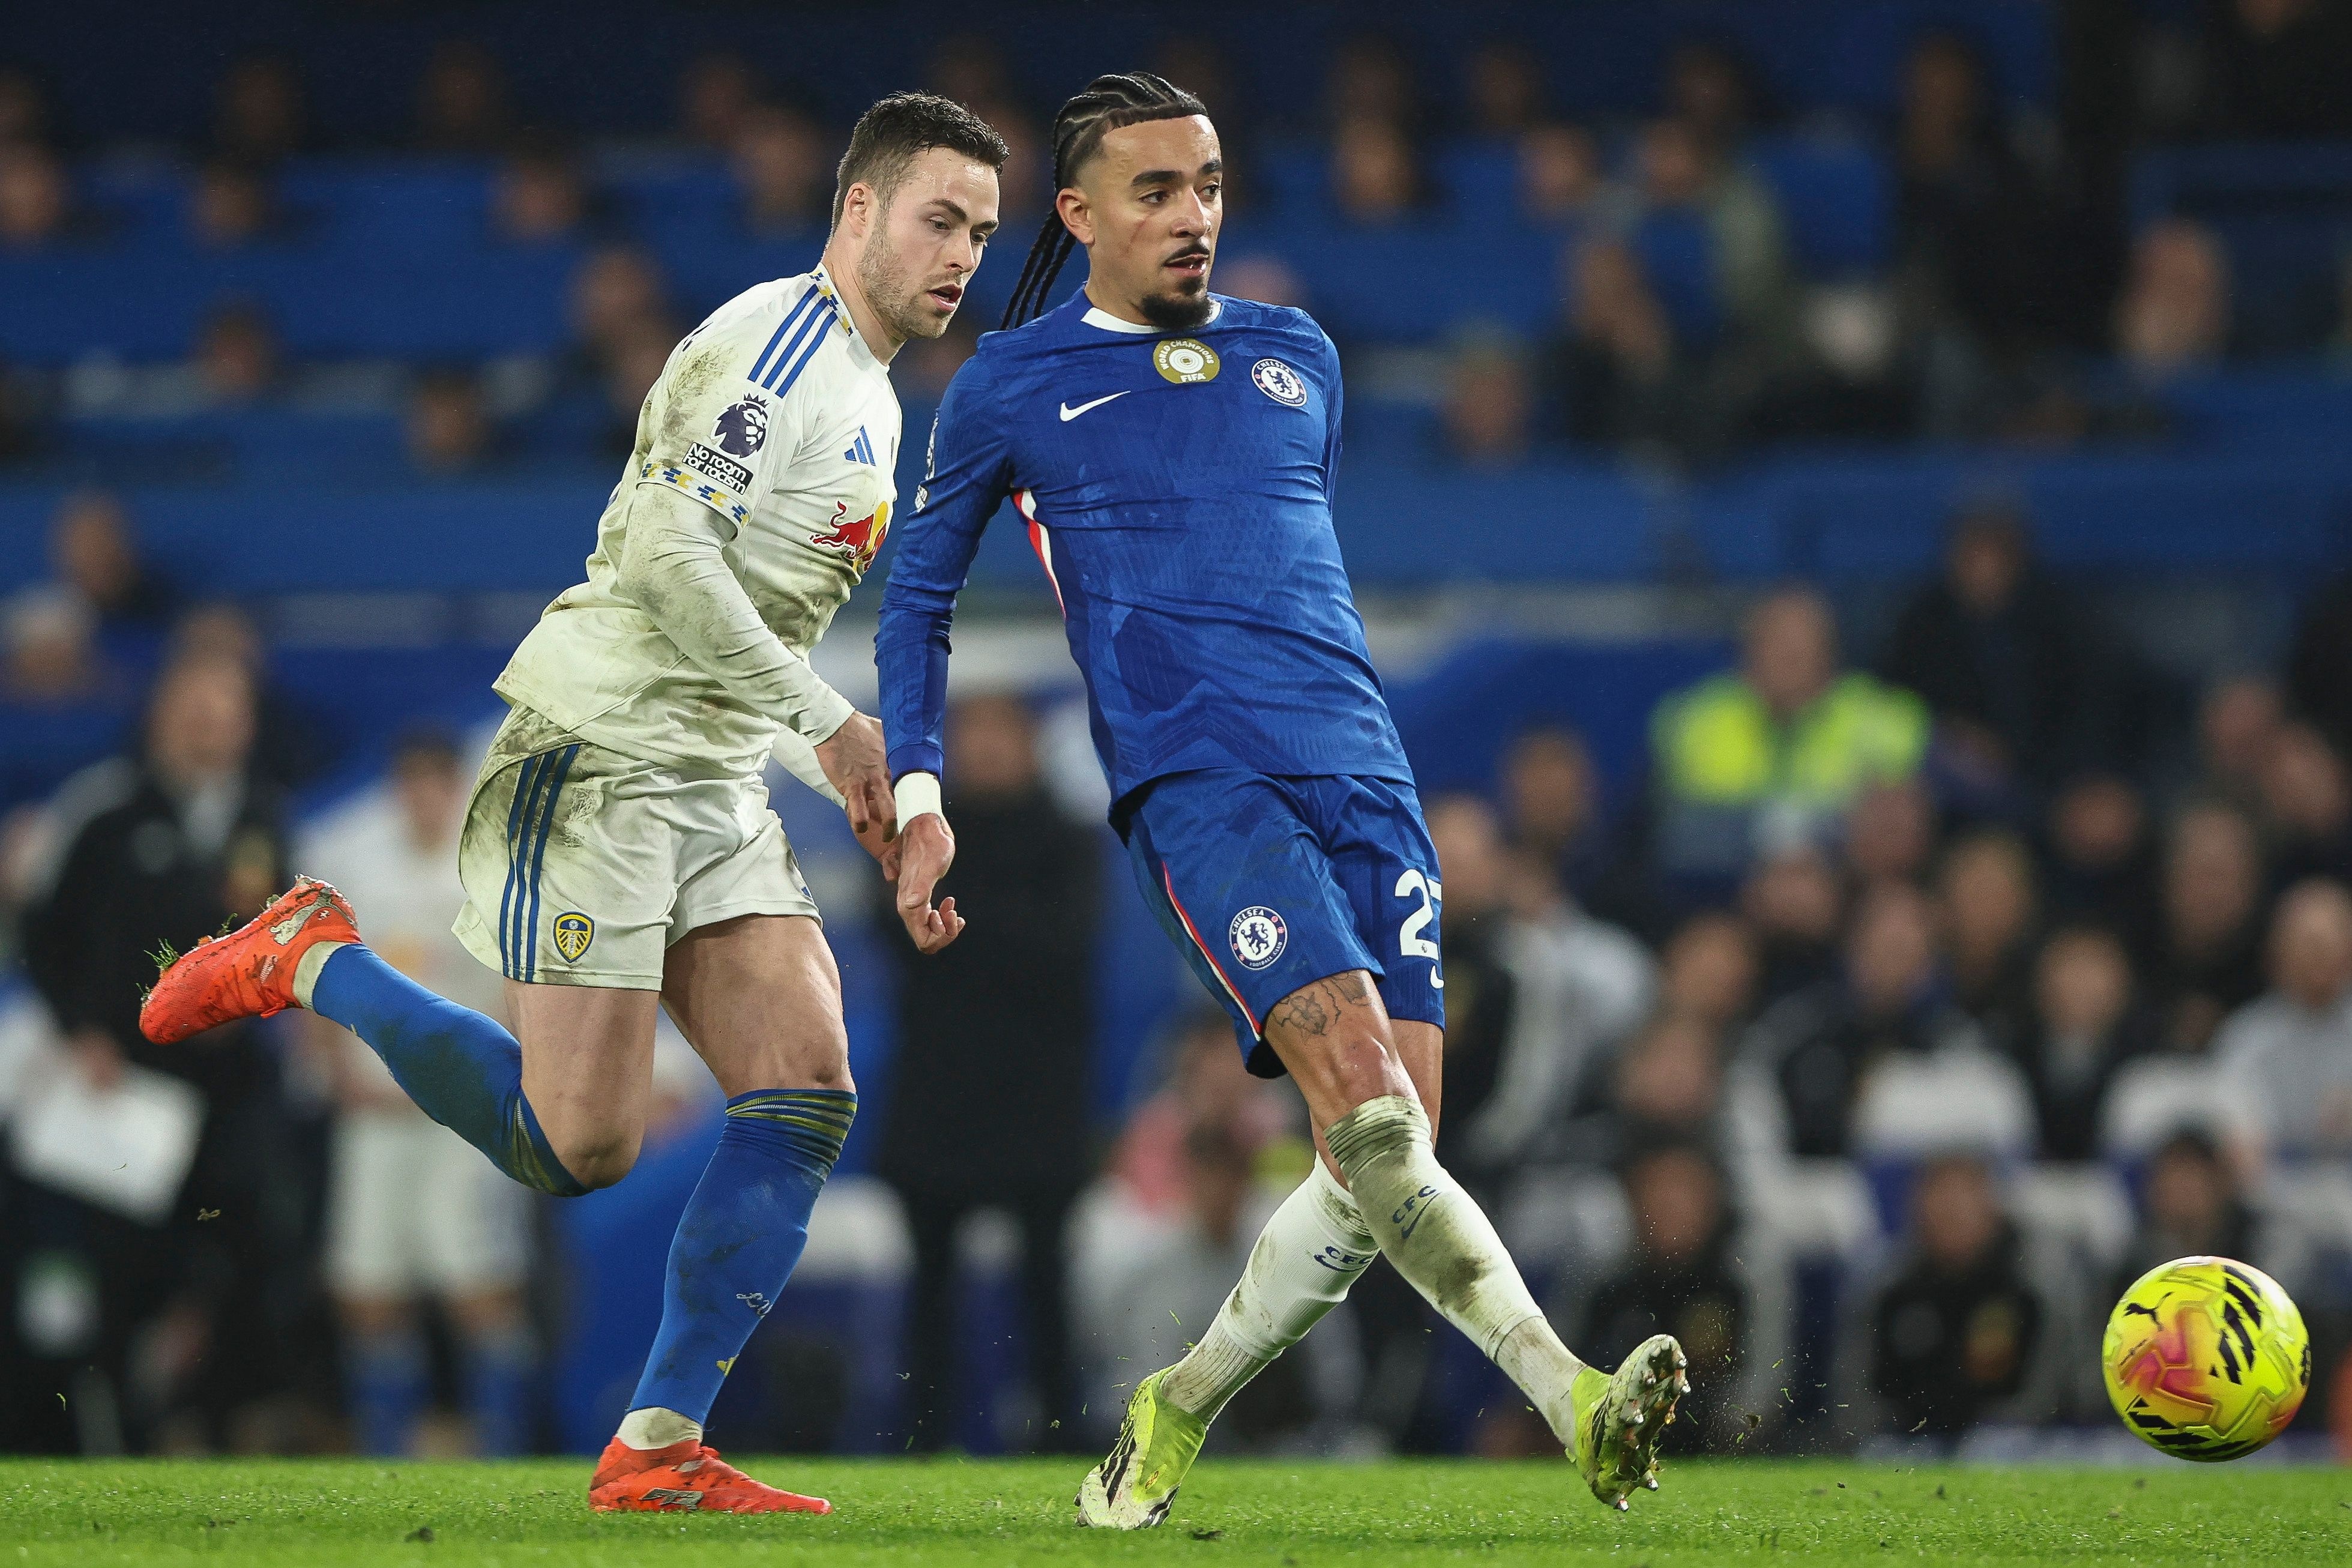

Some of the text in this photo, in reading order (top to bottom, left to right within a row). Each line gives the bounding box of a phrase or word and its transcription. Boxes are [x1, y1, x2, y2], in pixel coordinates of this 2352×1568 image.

[1159, 340, 1214, 370] WORLD CHAMPIONS
[1256, 361, 1290, 373] CHELSEA
[1180, 373, 1207, 383] FIFA
[683, 452, 746, 495] for racism
[687, 442, 747, 481] No room
[1232, 908, 1264, 935] CHELSEA
[1395, 869, 1442, 960] 2
[1392, 1185, 1437, 1223] CFC
